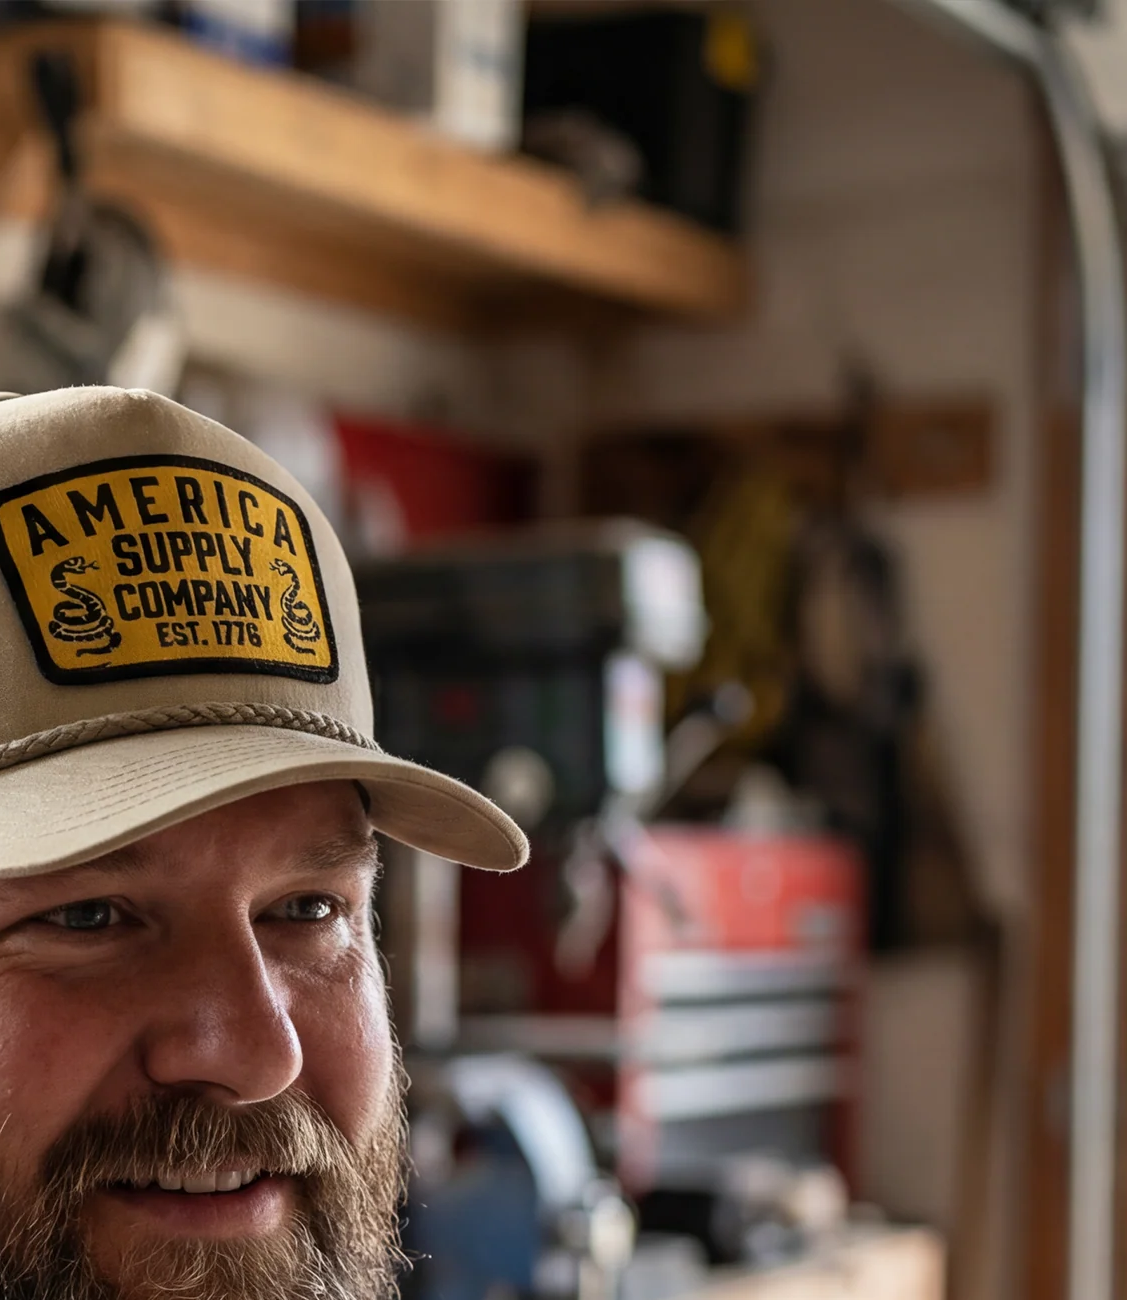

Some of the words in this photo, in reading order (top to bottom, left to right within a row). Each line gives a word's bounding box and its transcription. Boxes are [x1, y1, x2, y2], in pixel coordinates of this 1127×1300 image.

[20, 475, 297, 557] AMERICA
[111, 531, 255, 577] SUPPLY
[113, 579, 274, 622] COMPANY
[155, 621, 209, 647] EST.
[214, 620, 263, 648] 1776
